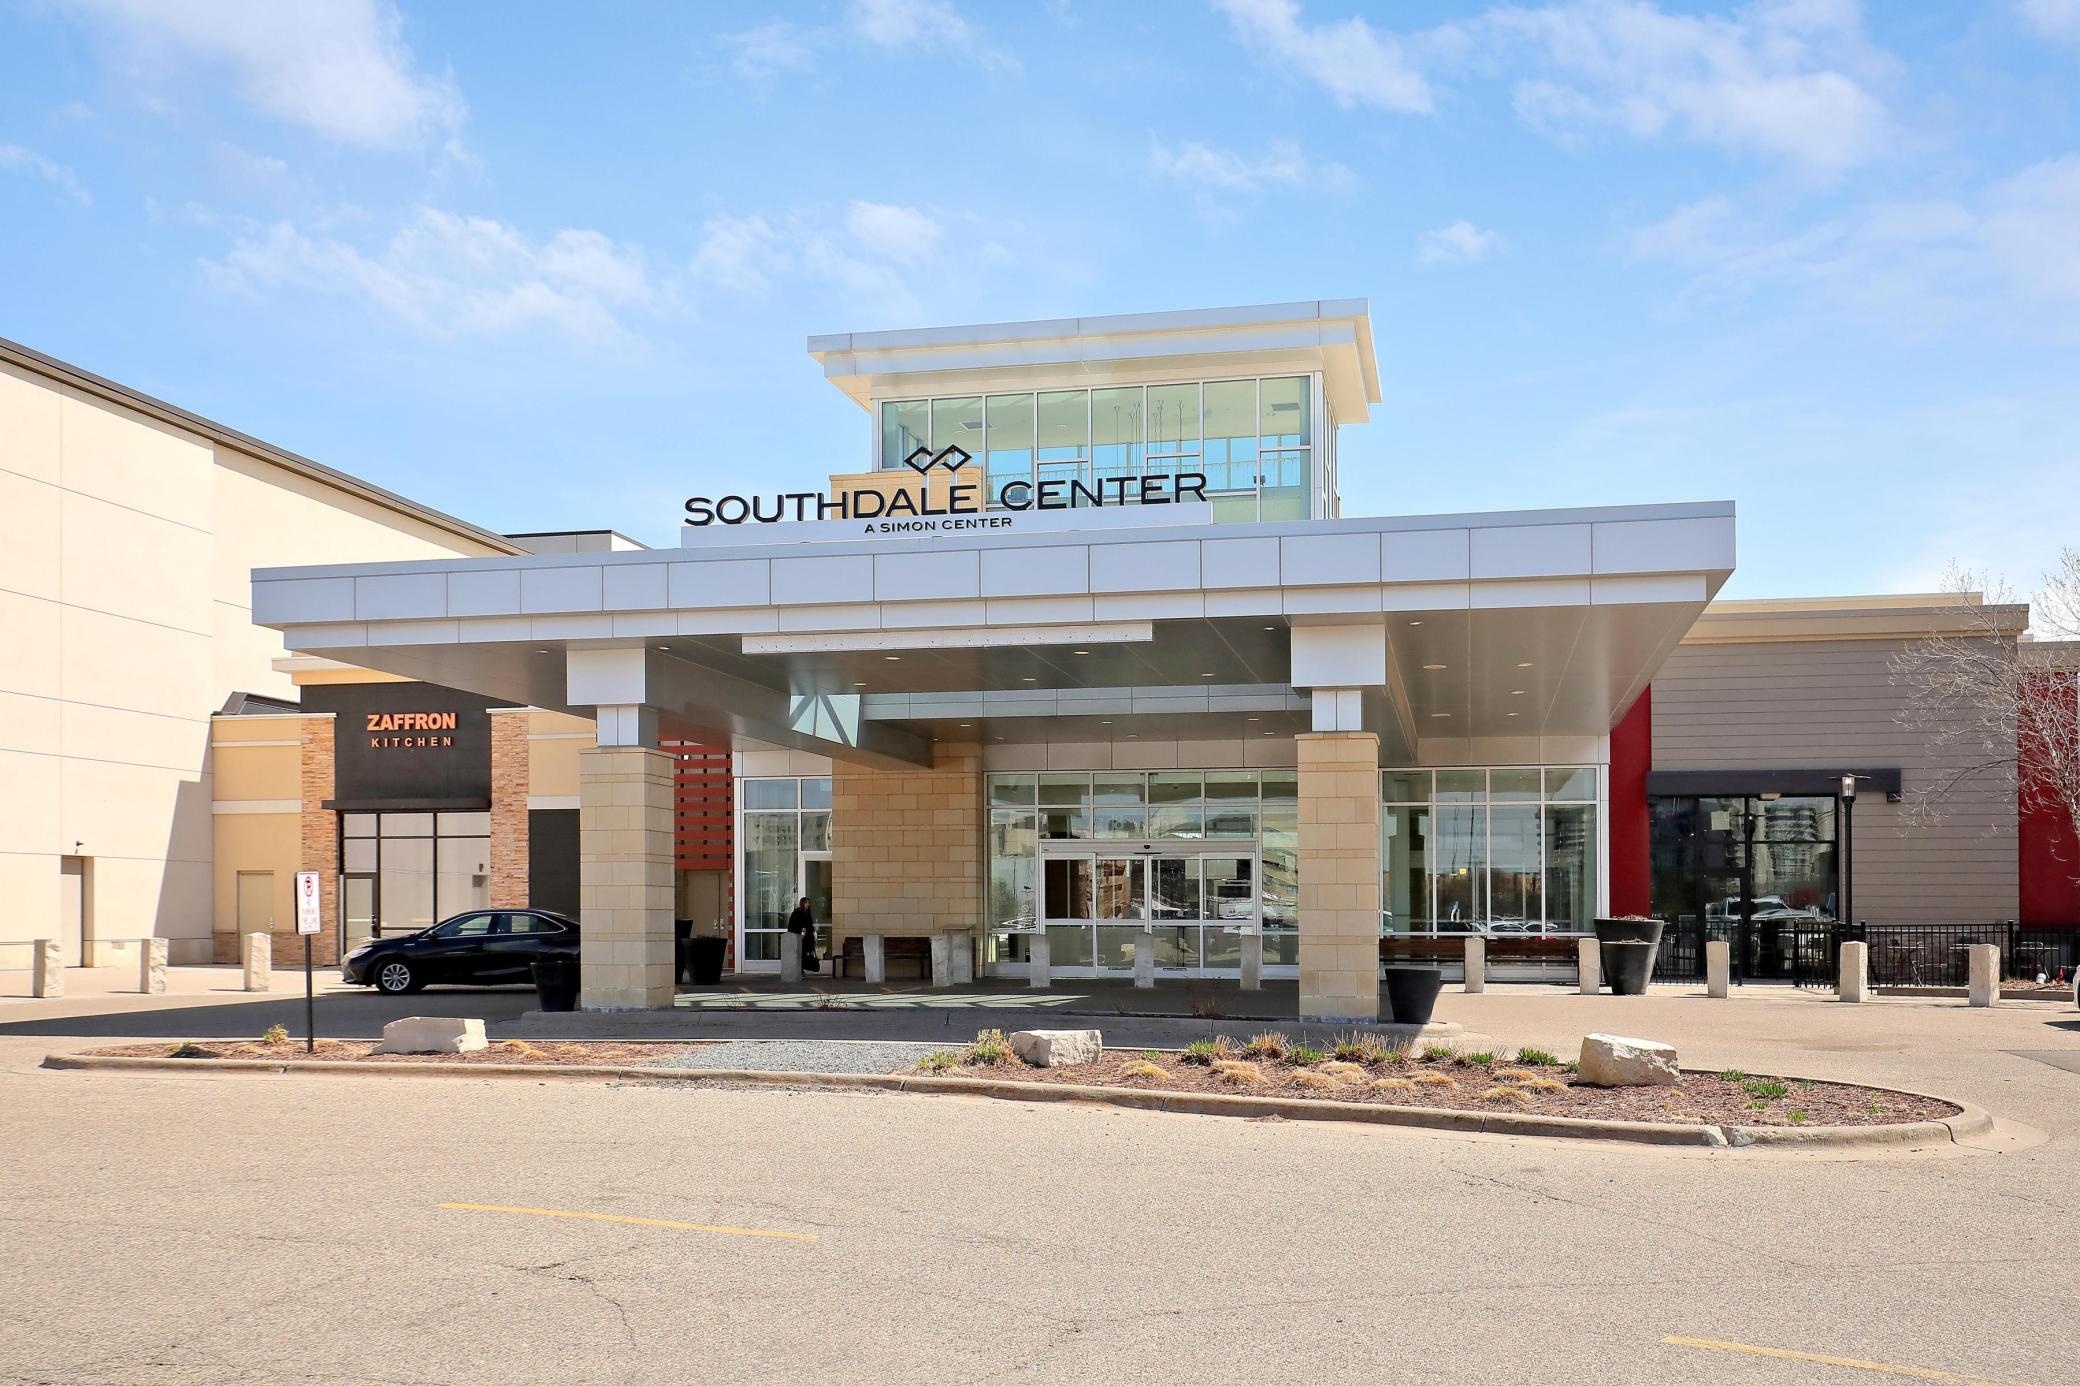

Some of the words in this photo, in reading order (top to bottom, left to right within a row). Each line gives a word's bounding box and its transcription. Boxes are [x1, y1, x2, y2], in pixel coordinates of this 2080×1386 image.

[684, 484, 978, 527] SOUTHDALE
[1000, 472, 1208, 511] CENTER
[864, 523, 876, 534] A
[880, 520, 936, 533] SIMON
[941, 516, 1012, 531] CENTER
[366, 712, 457, 731] ZAFFRON
[371, 736, 452, 748] KITCHEN
